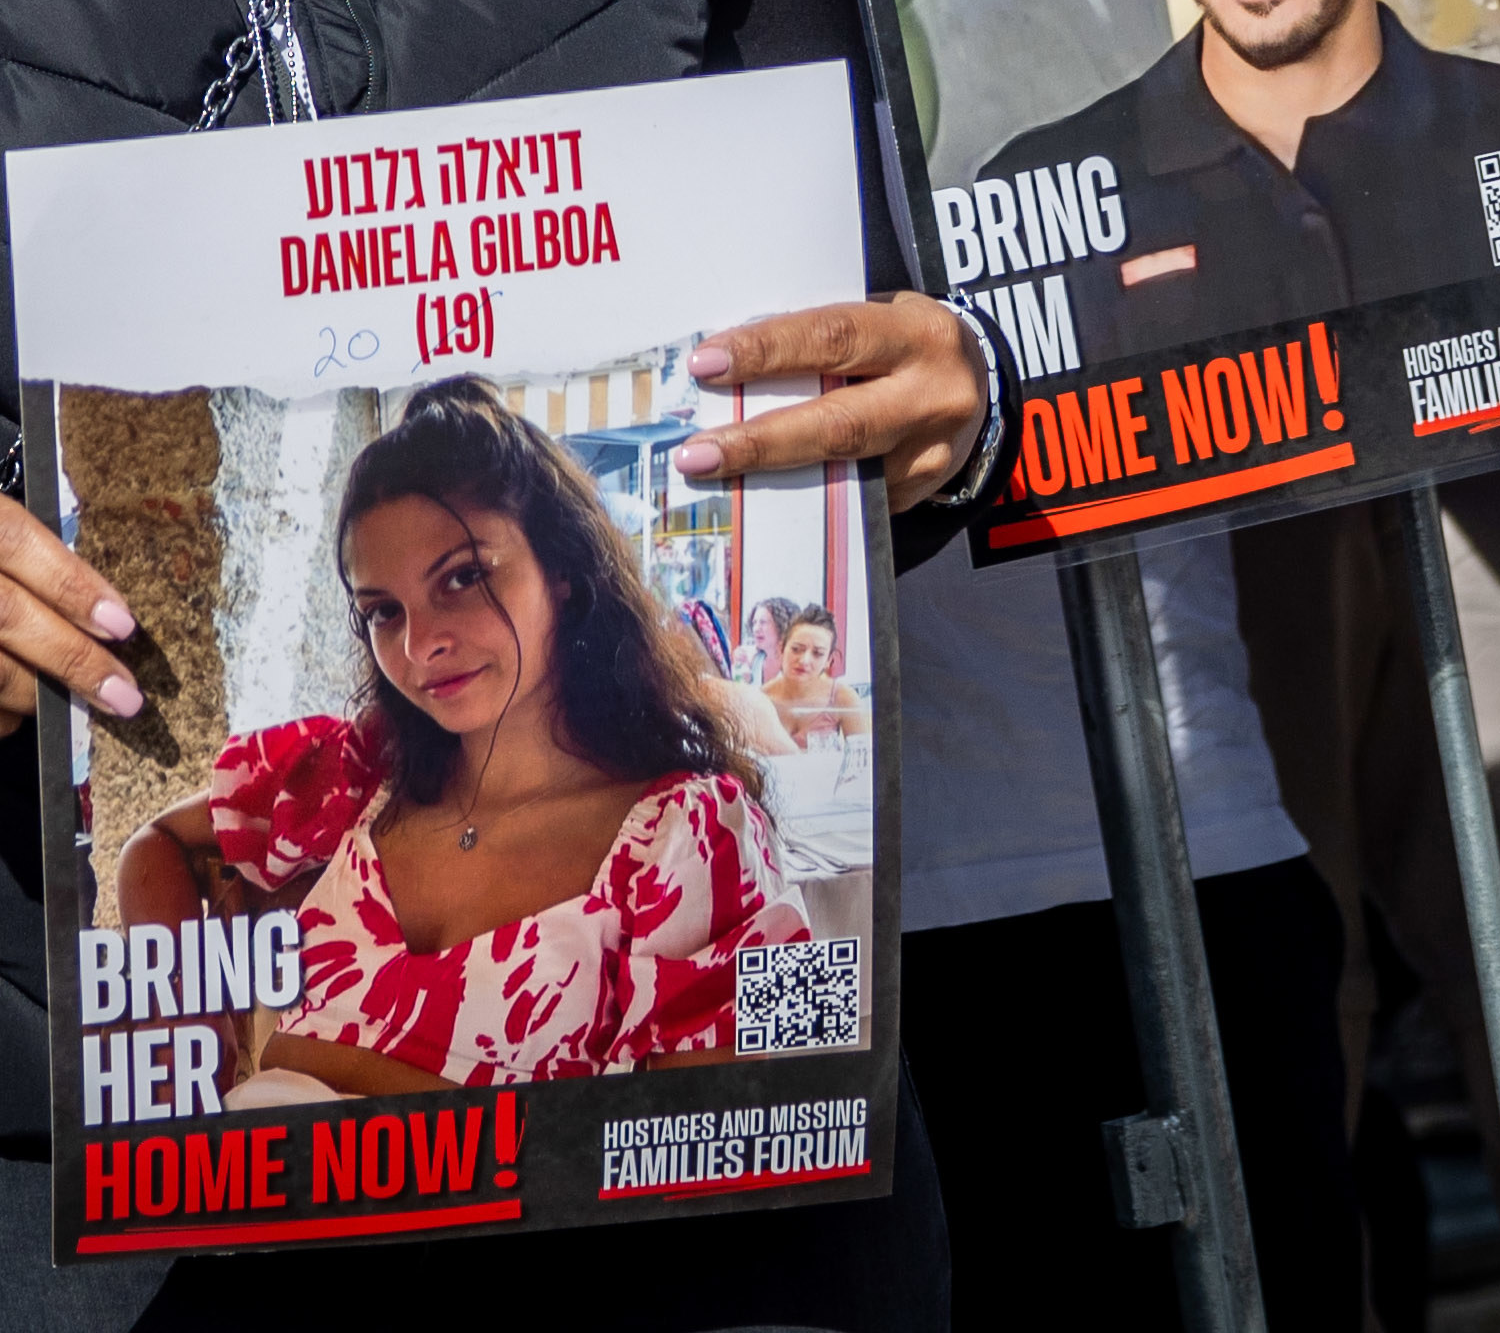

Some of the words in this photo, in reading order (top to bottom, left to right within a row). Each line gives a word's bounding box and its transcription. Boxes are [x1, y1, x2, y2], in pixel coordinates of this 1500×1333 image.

[305, 147, 426, 221] גלבוע
[438, 131, 582, 207] דניאלה
[281, 220, 458, 297] DANIELA
[470, 202, 620, 276] GILBOA
[931, 154, 1127, 285] BRING
[314, 326, 380, 377] 20
[416, 287, 495, 364] (19)
[1402, 334, 1497, 378] HOSTAGES
[992, 376, 1157, 507] OME
[1162, 321, 1347, 466] NOW!
[78, 909, 302, 1025] BRING
[83, 1026, 223, 1126] HER
[85, 1124, 287, 1221] HOME
[310, 1090, 527, 1204] NOW!
[603, 1139, 745, 1192] FAMILIES
[752, 1128, 865, 1175] FORUM
[604, 1112, 715, 1148] HOSTAGES
[719, 1108, 765, 1138] AND
[769, 1098, 867, 1133] MISSING
